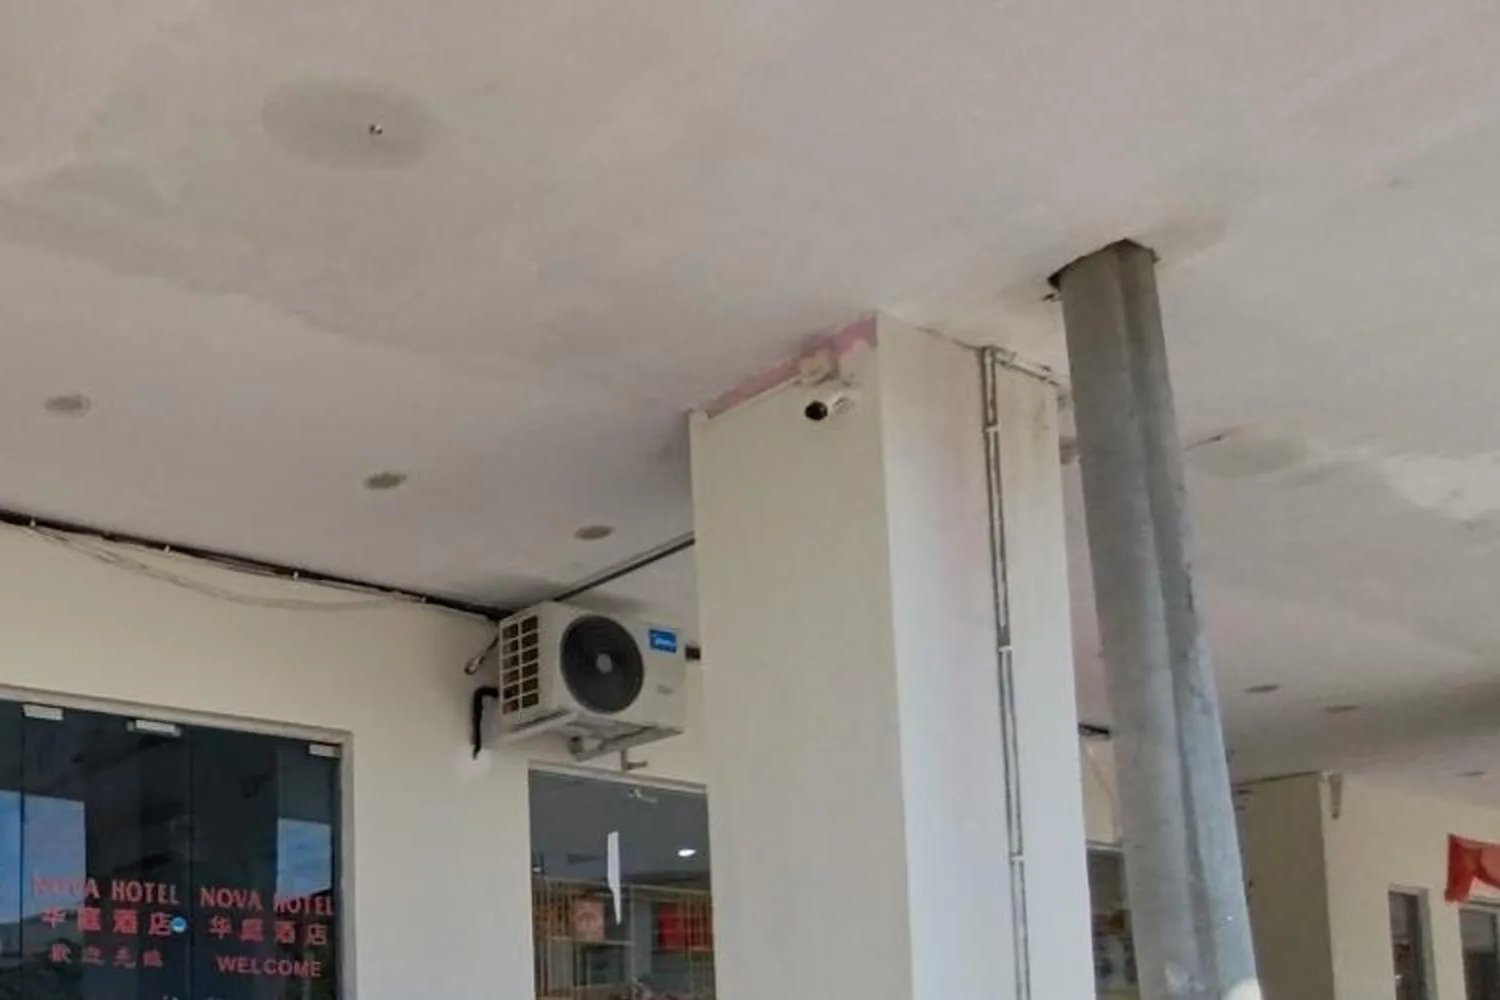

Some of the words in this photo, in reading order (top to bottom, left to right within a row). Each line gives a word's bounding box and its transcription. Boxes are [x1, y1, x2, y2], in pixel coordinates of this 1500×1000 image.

[111, 879, 179, 905] HOTEL
[200, 885, 263, 911] NOVA
[274, 893, 333, 916] HOTEL
[216, 954, 322, 978] WELCOME
